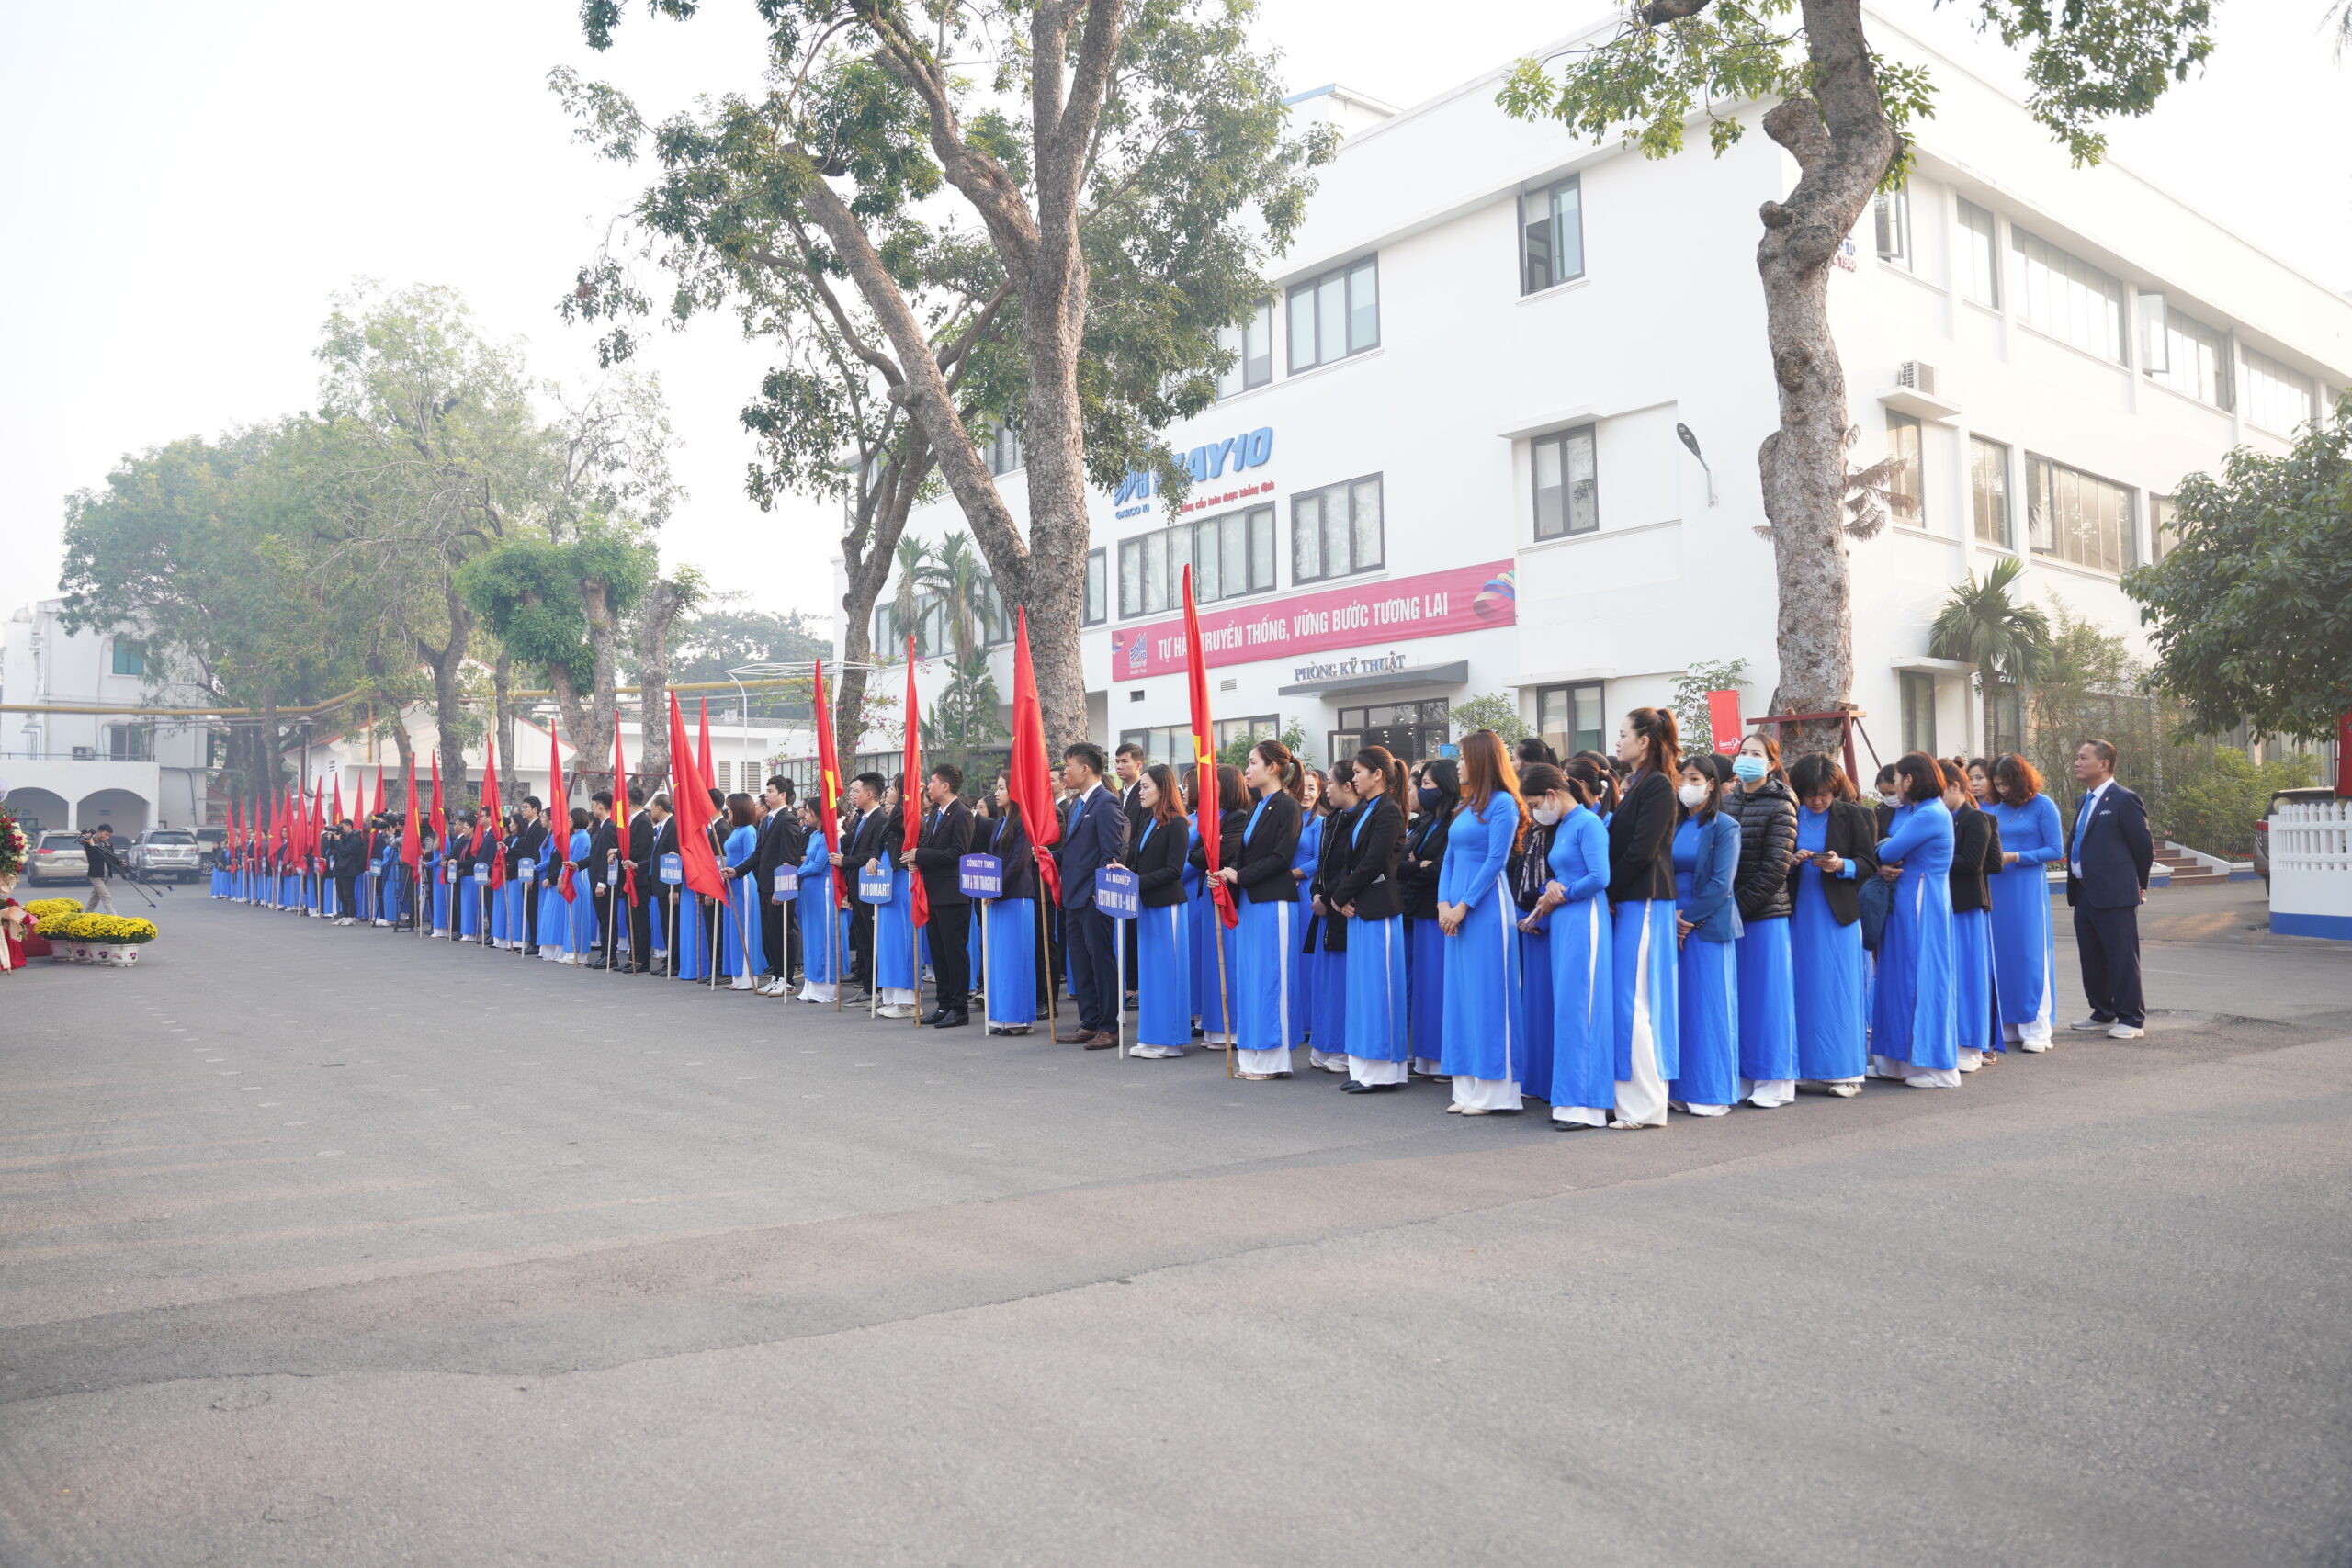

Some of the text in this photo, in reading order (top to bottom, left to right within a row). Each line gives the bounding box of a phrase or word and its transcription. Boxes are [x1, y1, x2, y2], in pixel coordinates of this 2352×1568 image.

[1115, 506, 1141, 520] GARCO
[1158, 592, 1448, 662] TỰ HÀ TRUYỀN THỐNG, VỮNG BƯỚC TƯƠNG LAI
[1295, 650, 1407, 682] PHÒNG KỸ THUẬT
[967, 858, 978, 867] CÔNG
[1106, 872, 1131, 886] XÍ NGHIỆP
[861, 883, 890, 896] M10MART
